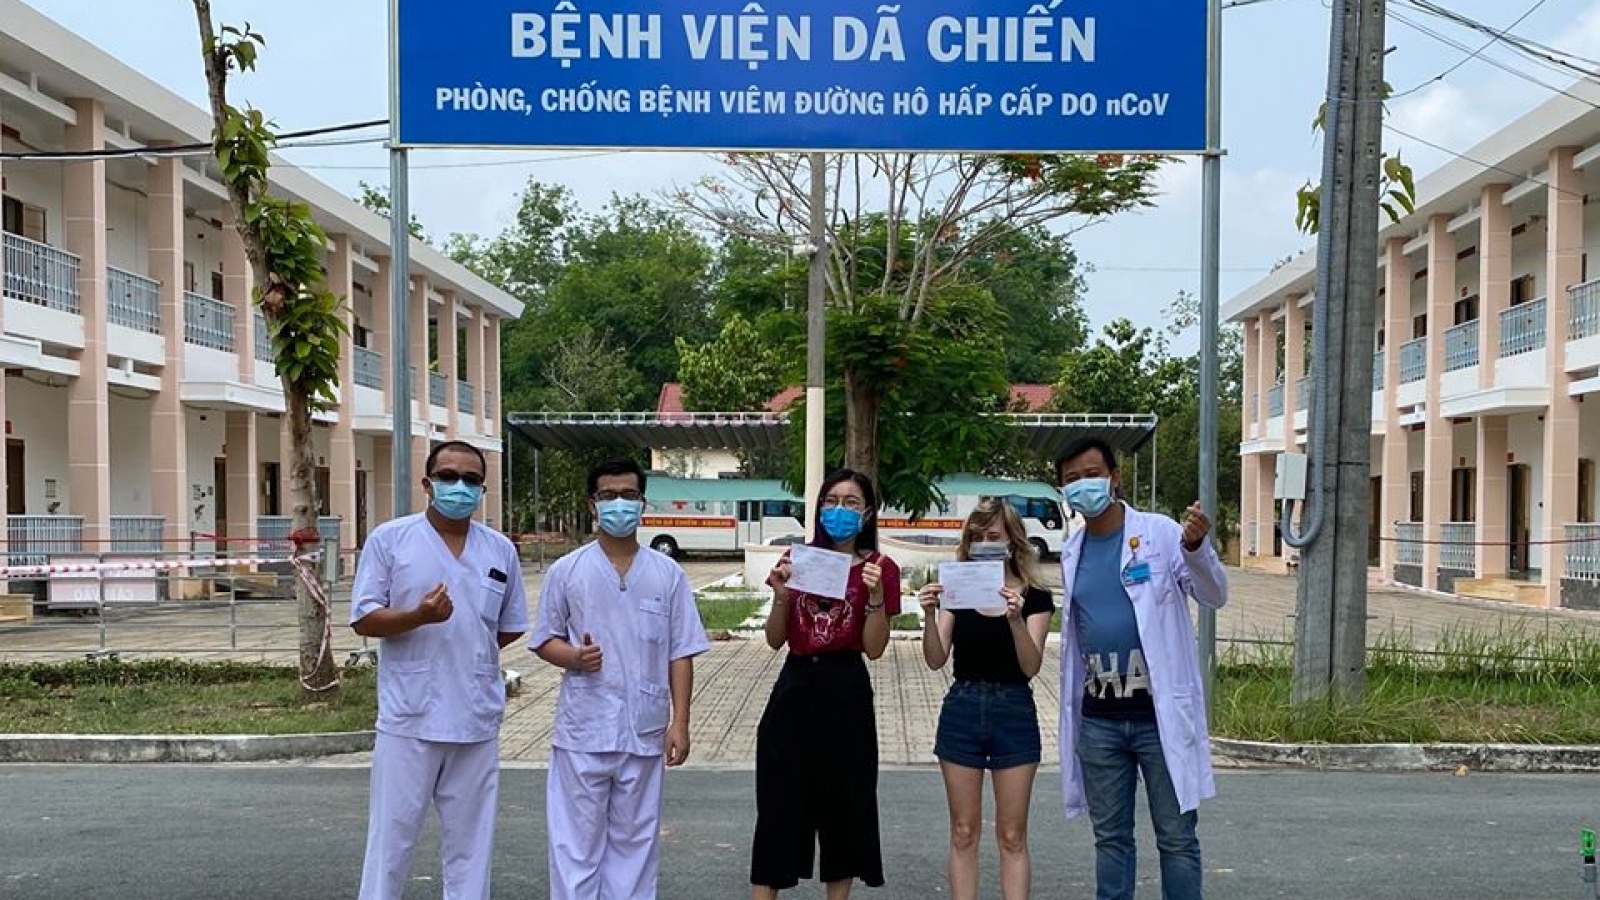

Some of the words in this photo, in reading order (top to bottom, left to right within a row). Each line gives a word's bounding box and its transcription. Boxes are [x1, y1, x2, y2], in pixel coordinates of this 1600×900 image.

[511, 1, 661, 68] BỆNH
[682, 3, 811, 70] VIỆN
[833, 5, 906, 61] DÃ
[927, 0, 1096, 63] CHIẾN
[436, 82, 532, 115] PHÒNG,
[541, 81, 631, 113] CHỐNG
[639, 85, 711, 117] BỆNH
[720, 85, 786, 114] VIÊM
[794, 86, 884, 116] ĐƯỜNG
[893, 87, 929, 116] HÔ
[939, 84, 993, 116] HẤP
[1000, 84, 1053, 116] CẤP
[1061, 93, 1098, 116] DO
[1106, 93, 1169, 116] nCoV
